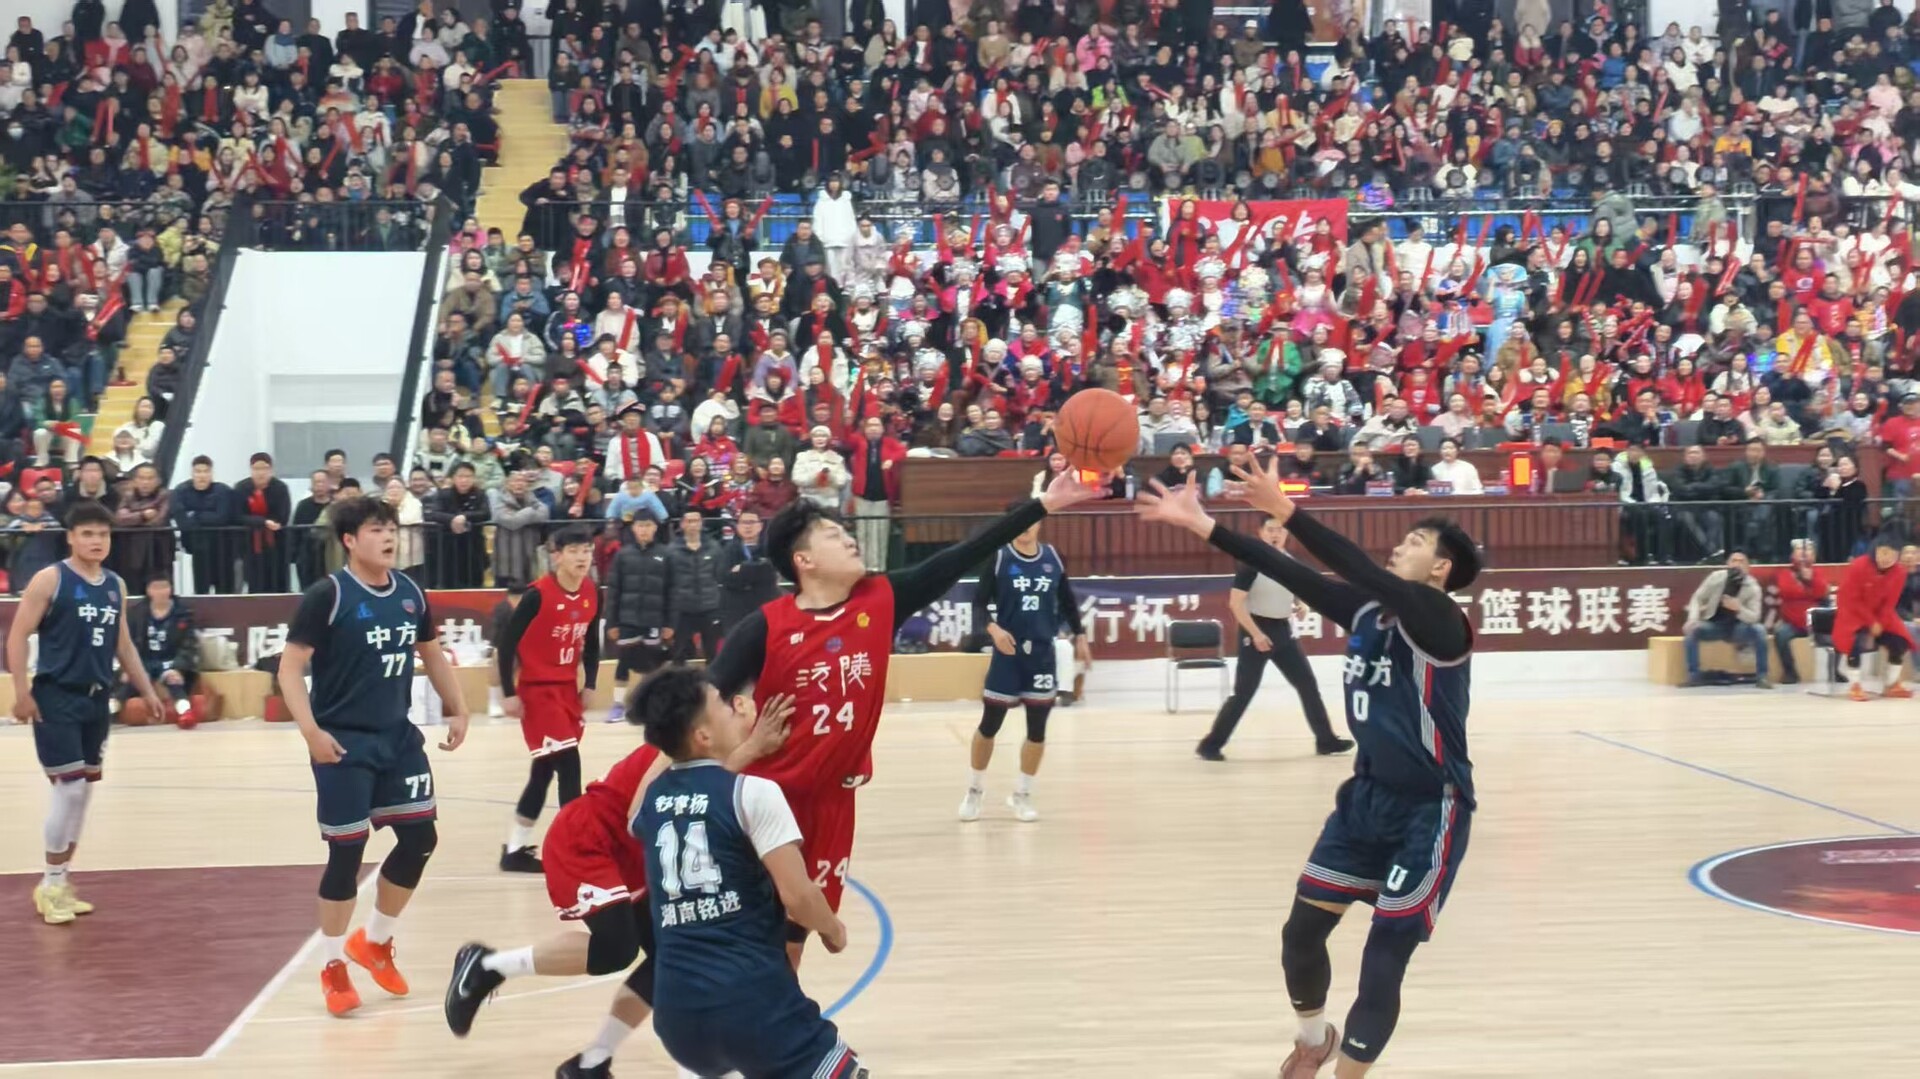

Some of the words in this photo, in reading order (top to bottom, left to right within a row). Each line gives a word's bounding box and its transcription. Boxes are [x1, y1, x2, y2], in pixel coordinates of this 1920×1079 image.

[1012, 576, 1052, 592] 中方
[78, 603, 119, 626] 中方
[1021, 595, 1040, 611] 23
[91, 627, 104, 647] 5
[366, 621, 417, 650] 中方
[381, 652, 407, 678] 77
[1343, 654, 1392, 688] 中方
[1033, 674, 1054, 689] 23
[812, 701, 854, 736] 24
[1353, 690, 1370, 722] 0
[405, 773, 431, 799] 77
[655, 820, 723, 900] 14
[815, 857, 849, 888] 24
